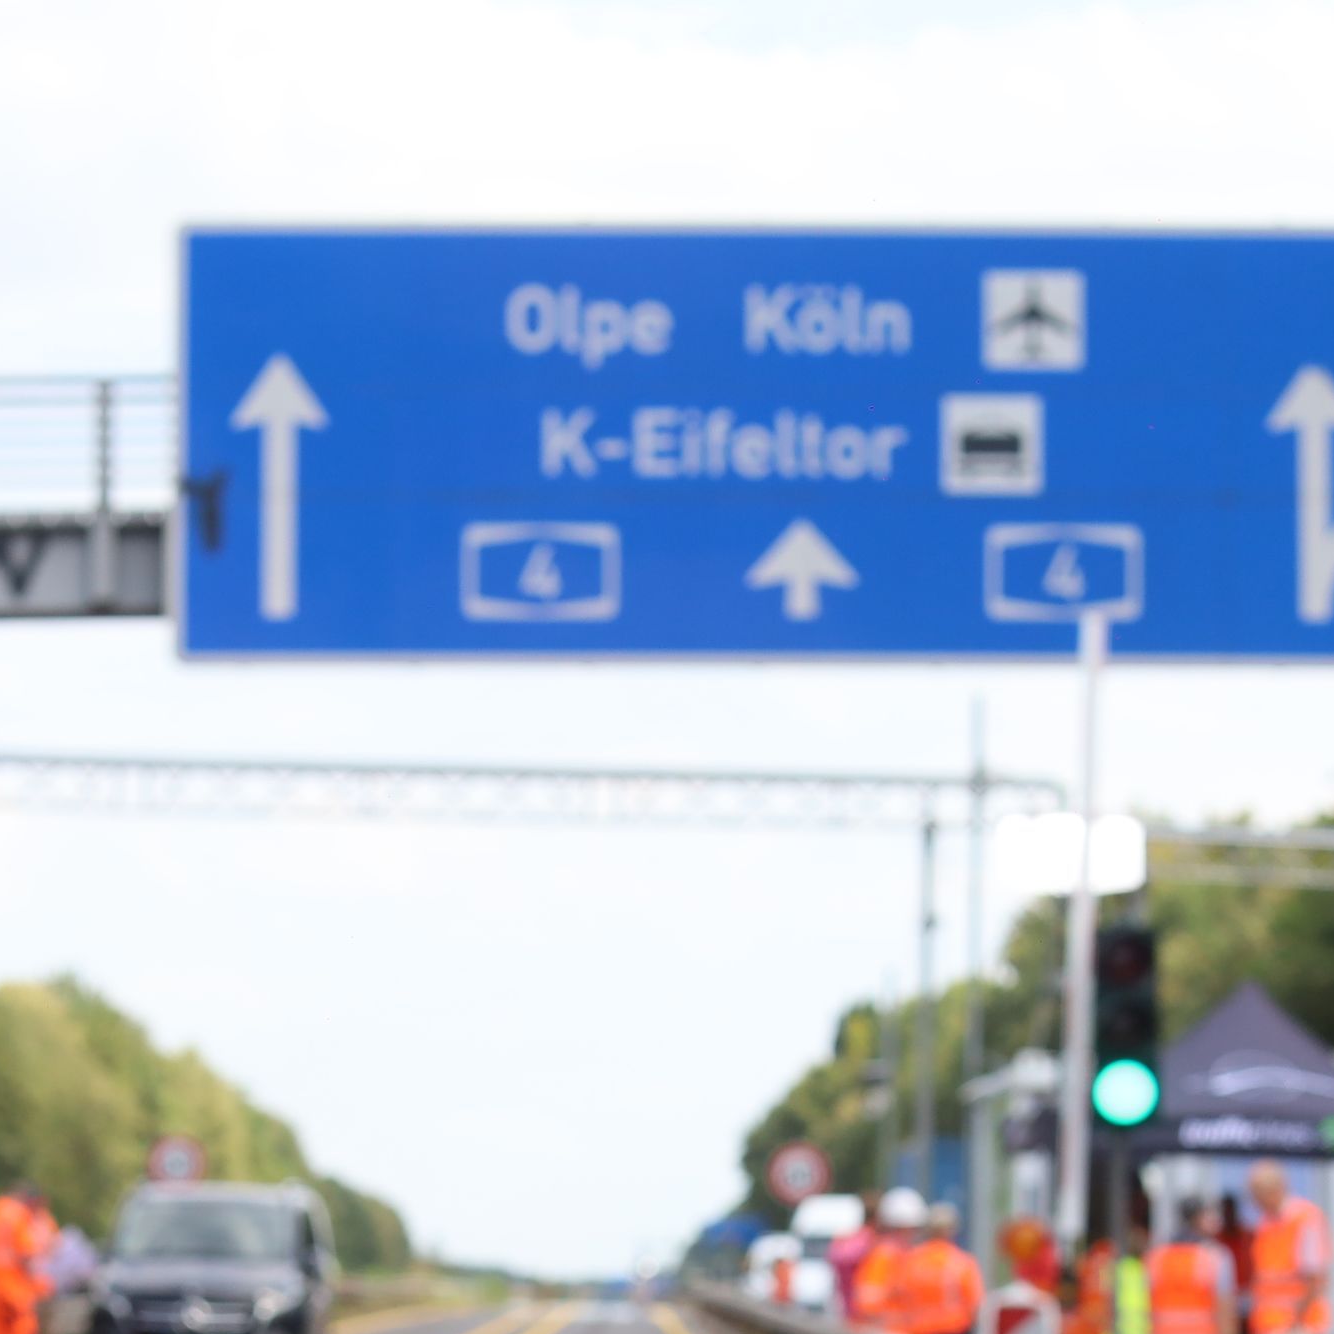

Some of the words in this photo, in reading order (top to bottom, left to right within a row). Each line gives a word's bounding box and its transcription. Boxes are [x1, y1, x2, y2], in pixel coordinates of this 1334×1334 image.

[505, 284, 673, 368] Olpe
[744, 283, 912, 354] Köln
[540, 406, 907, 480] K-Eifeltor
[518, 541, 565, 601] 4
[1042, 541, 1088, 601] 4
